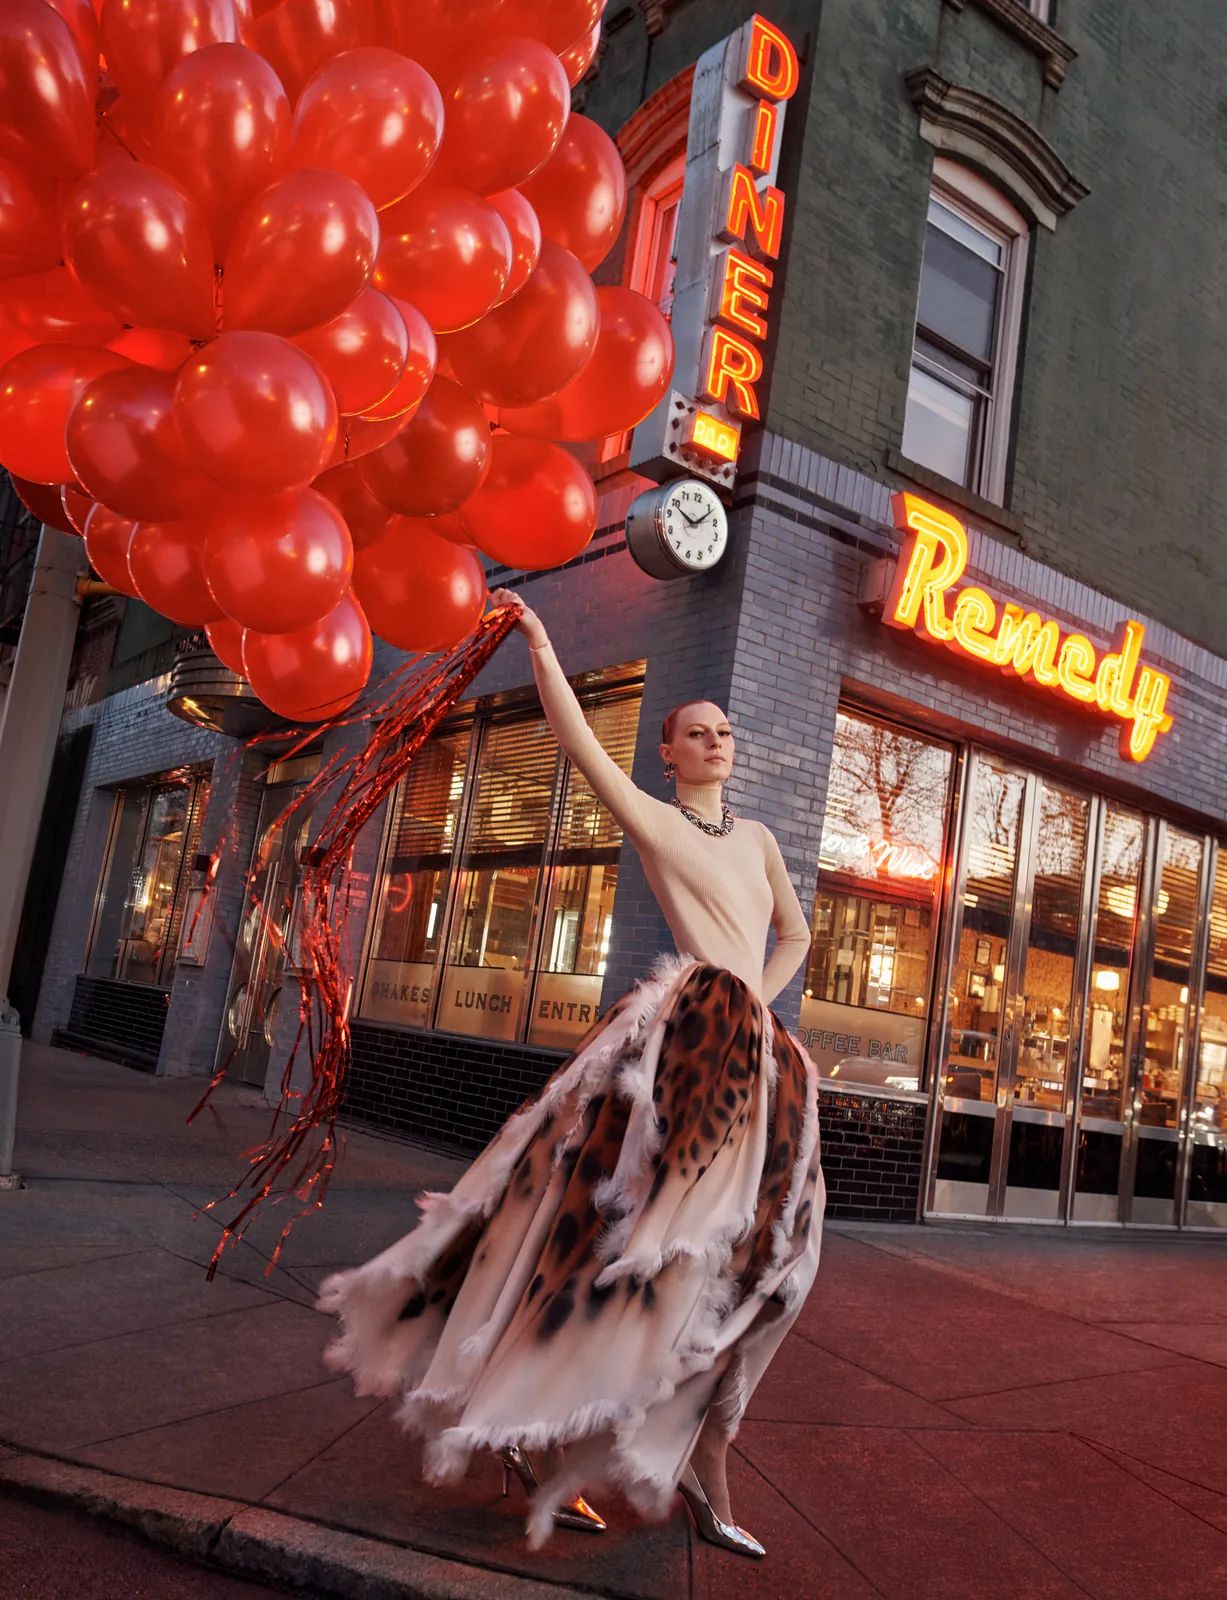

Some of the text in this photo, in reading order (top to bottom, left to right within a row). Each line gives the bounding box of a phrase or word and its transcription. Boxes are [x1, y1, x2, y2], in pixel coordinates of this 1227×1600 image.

[707, 13, 799, 421] DINER
[681, 490, 690, 501] 11
[693, 492, 703, 503] 12
[672, 498, 681, 508] 10
[667, 509, 672, 518] 9
[712, 518, 718, 528] 2
[668, 525, 673, 535] 8
[713, 532, 719, 542] 3
[675, 540, 681, 549] 7
[708, 544, 713, 554] 4
[685, 550, 691, 559] 6
[697, 551, 703, 561] 5
[887, 491, 1174, 763] Remedy
[371, 980, 431, 1004] SHAKES
[454, 989, 513, 1014] LUNCH
[798, 1026, 908, 1064] OFFEE BAR
